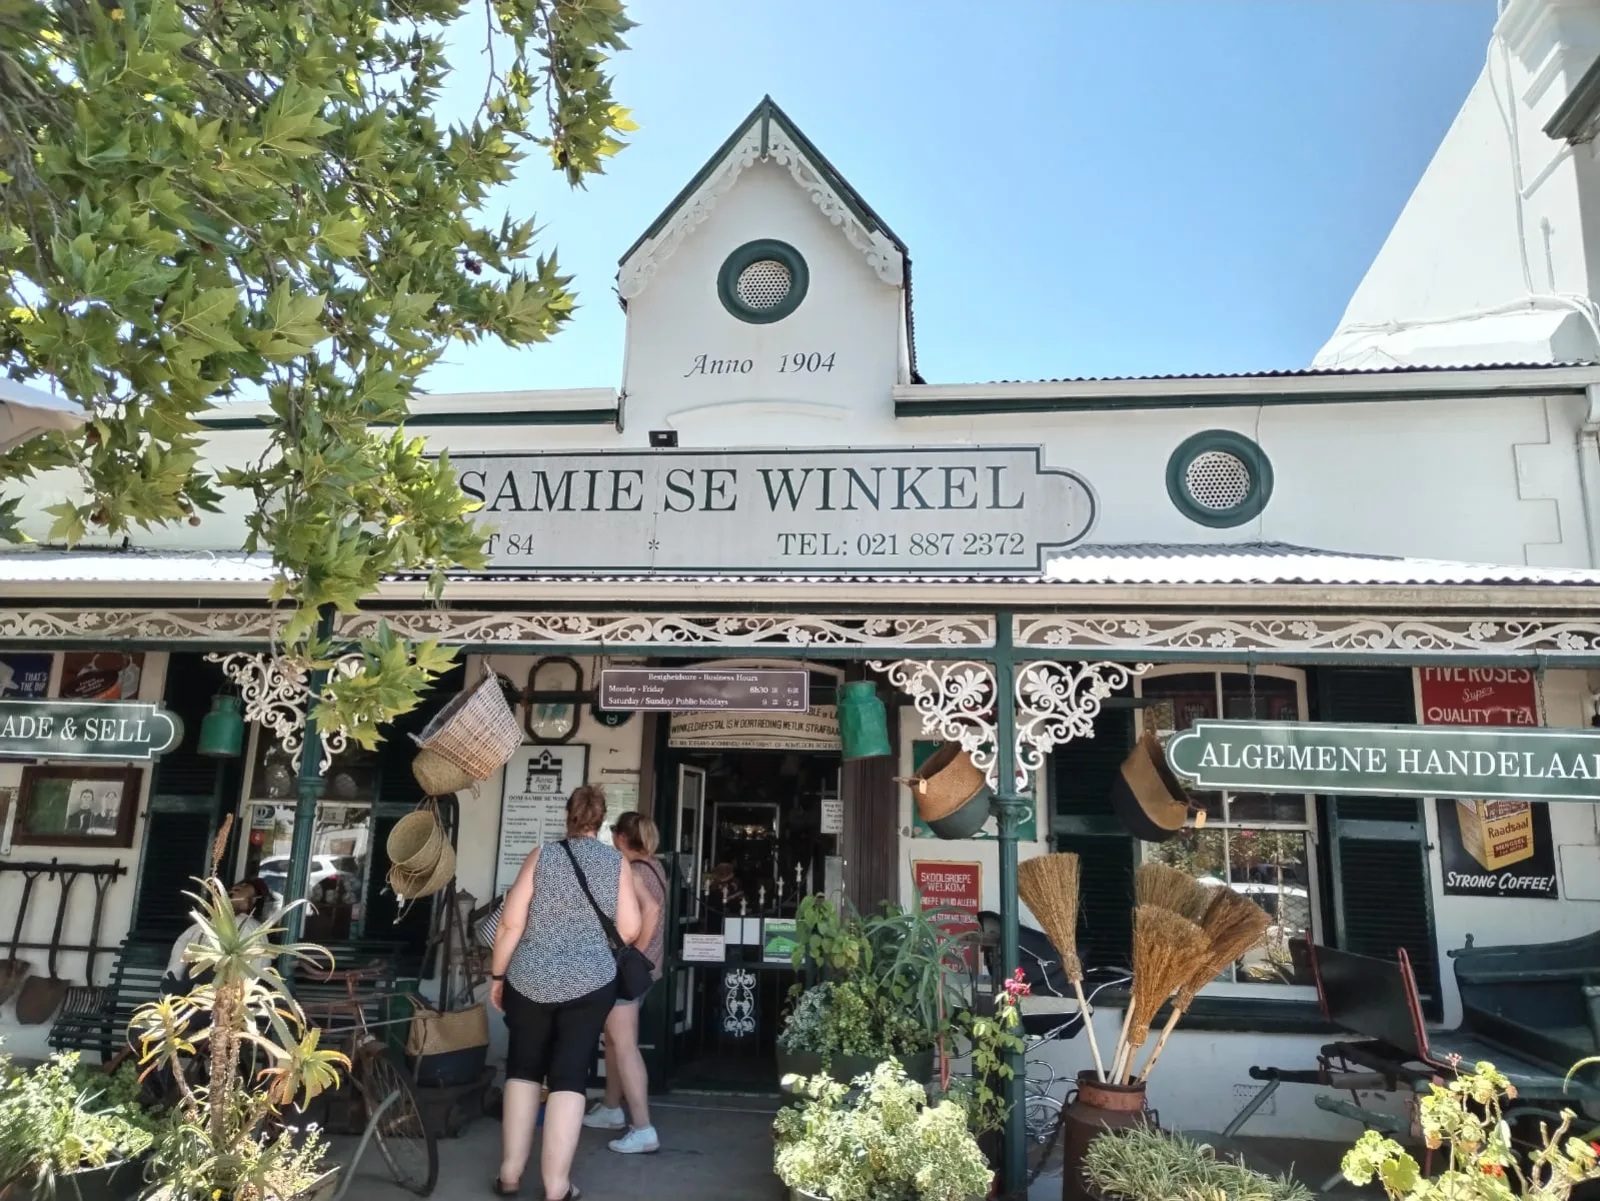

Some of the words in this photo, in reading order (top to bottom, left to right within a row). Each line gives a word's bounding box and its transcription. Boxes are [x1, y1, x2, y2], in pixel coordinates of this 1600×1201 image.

[684, 354, 754, 378] Anno
[777, 352, 836, 373] 1904
[459, 469, 644, 512] SAMIE
[664, 468, 738, 512] SE
[756, 466, 1025, 512] WINKEL
[506, 533, 534, 555] 84
[777, 533, 848, 556] TEL:
[857, 533, 900, 556] 021
[909, 533, 955, 556] 887
[963, 532, 1025, 555] 2372
[703, 673, 734, 681] Business
[735, 674, 758, 682] Hours
[1426, 667, 1465, 682] FIVE
[1469, 667, 1531, 684] ROSES
[608, 685, 636, 693] Monday
[642, 685, 664, 693] Friday
[608, 697, 639, 706] Saturday
[675, 698, 698, 706] Public
[699, 698, 728, 707] holidays
[1428, 706, 1491, 724] QUALITY
[1501, 707, 1534, 724] TEA
[60, 717, 77, 741] &
[83, 717, 151, 743] SELL
[1198, 742, 1387, 773] ALGEMENE
[534, 776, 553, 784] Anno
[1487, 817, 1529, 839] Raadsaal
[926, 882, 966, 893] WELKOM
[1446, 871, 1497, 889] STRONG
[1498, 872, 1555, 892] COFFEE!
